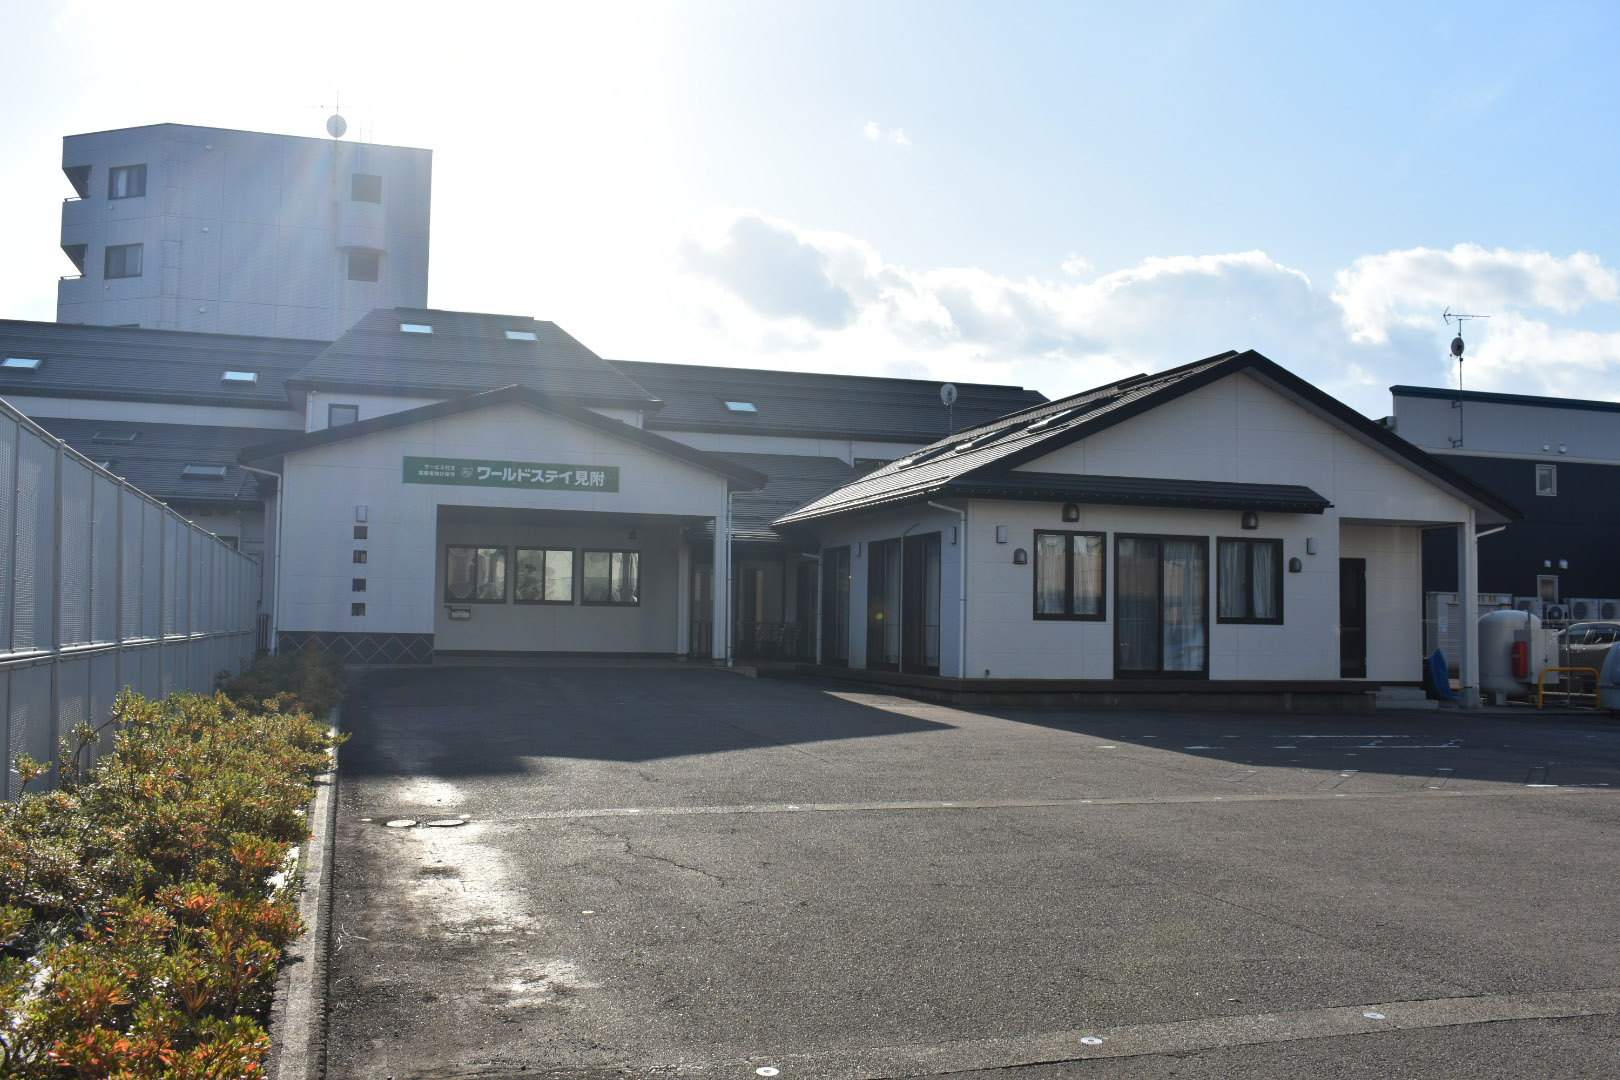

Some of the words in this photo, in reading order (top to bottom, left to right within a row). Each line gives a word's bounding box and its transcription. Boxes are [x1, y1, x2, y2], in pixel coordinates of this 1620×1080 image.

[477, 466, 605, 487] ワールドステイ見附
